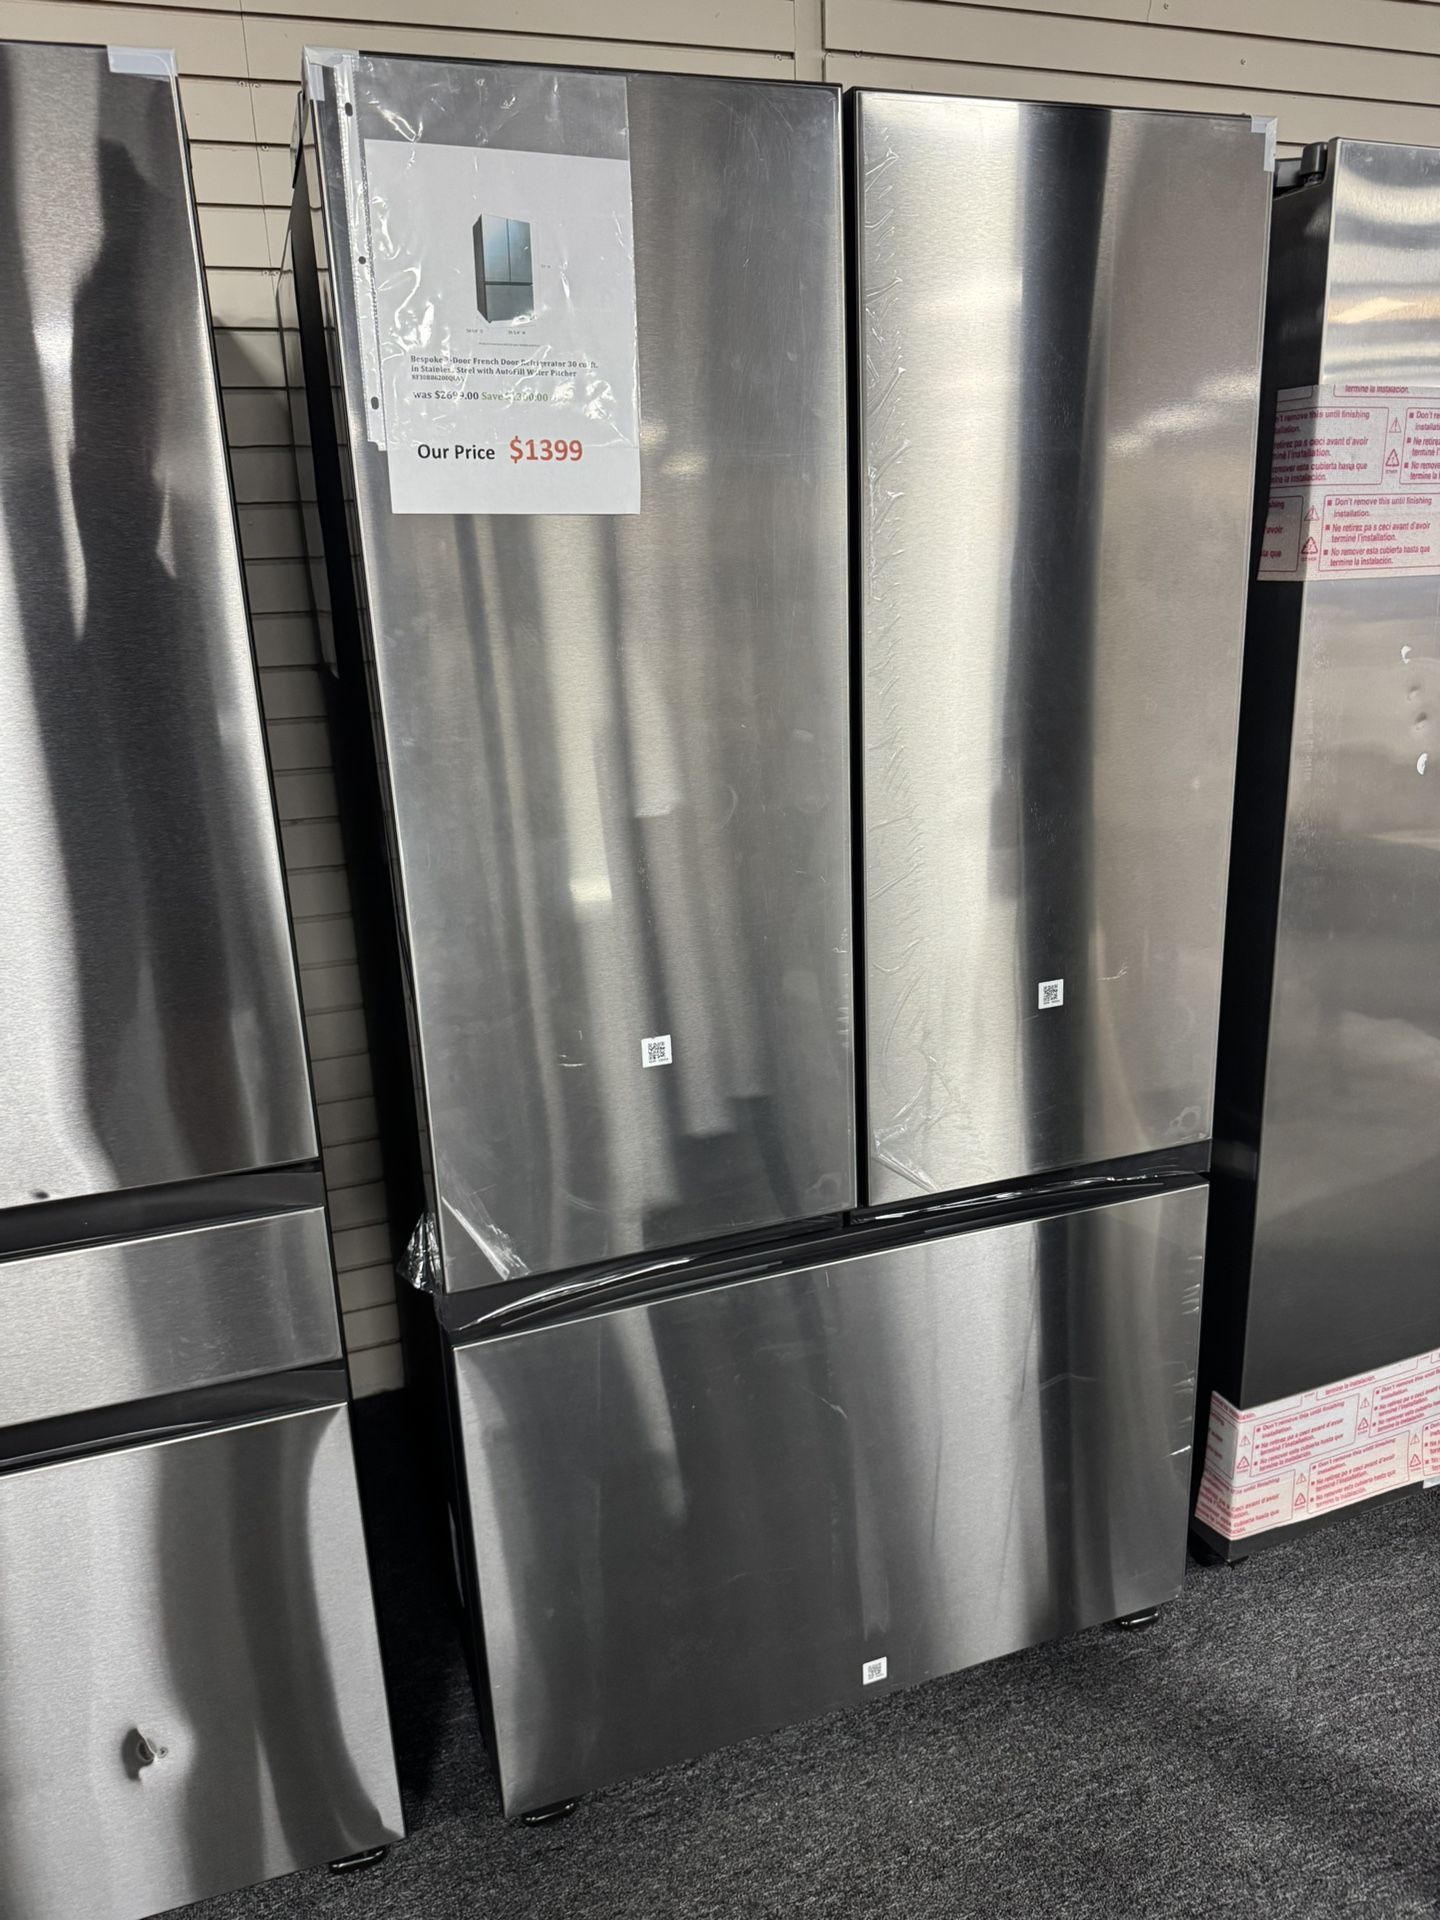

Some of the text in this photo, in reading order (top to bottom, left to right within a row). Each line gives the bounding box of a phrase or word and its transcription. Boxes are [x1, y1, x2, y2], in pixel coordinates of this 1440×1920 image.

[411, 356, 442, 364] Bespoke
[473, 357, 498, 365] French
[501, 358, 519, 366] Door
[457, 366, 475, 374] Steel
[481, 392, 504, 400] Save
[418, 436, 583, 464] Our Price $1399
[1420, 462, 1440, 470] remove
